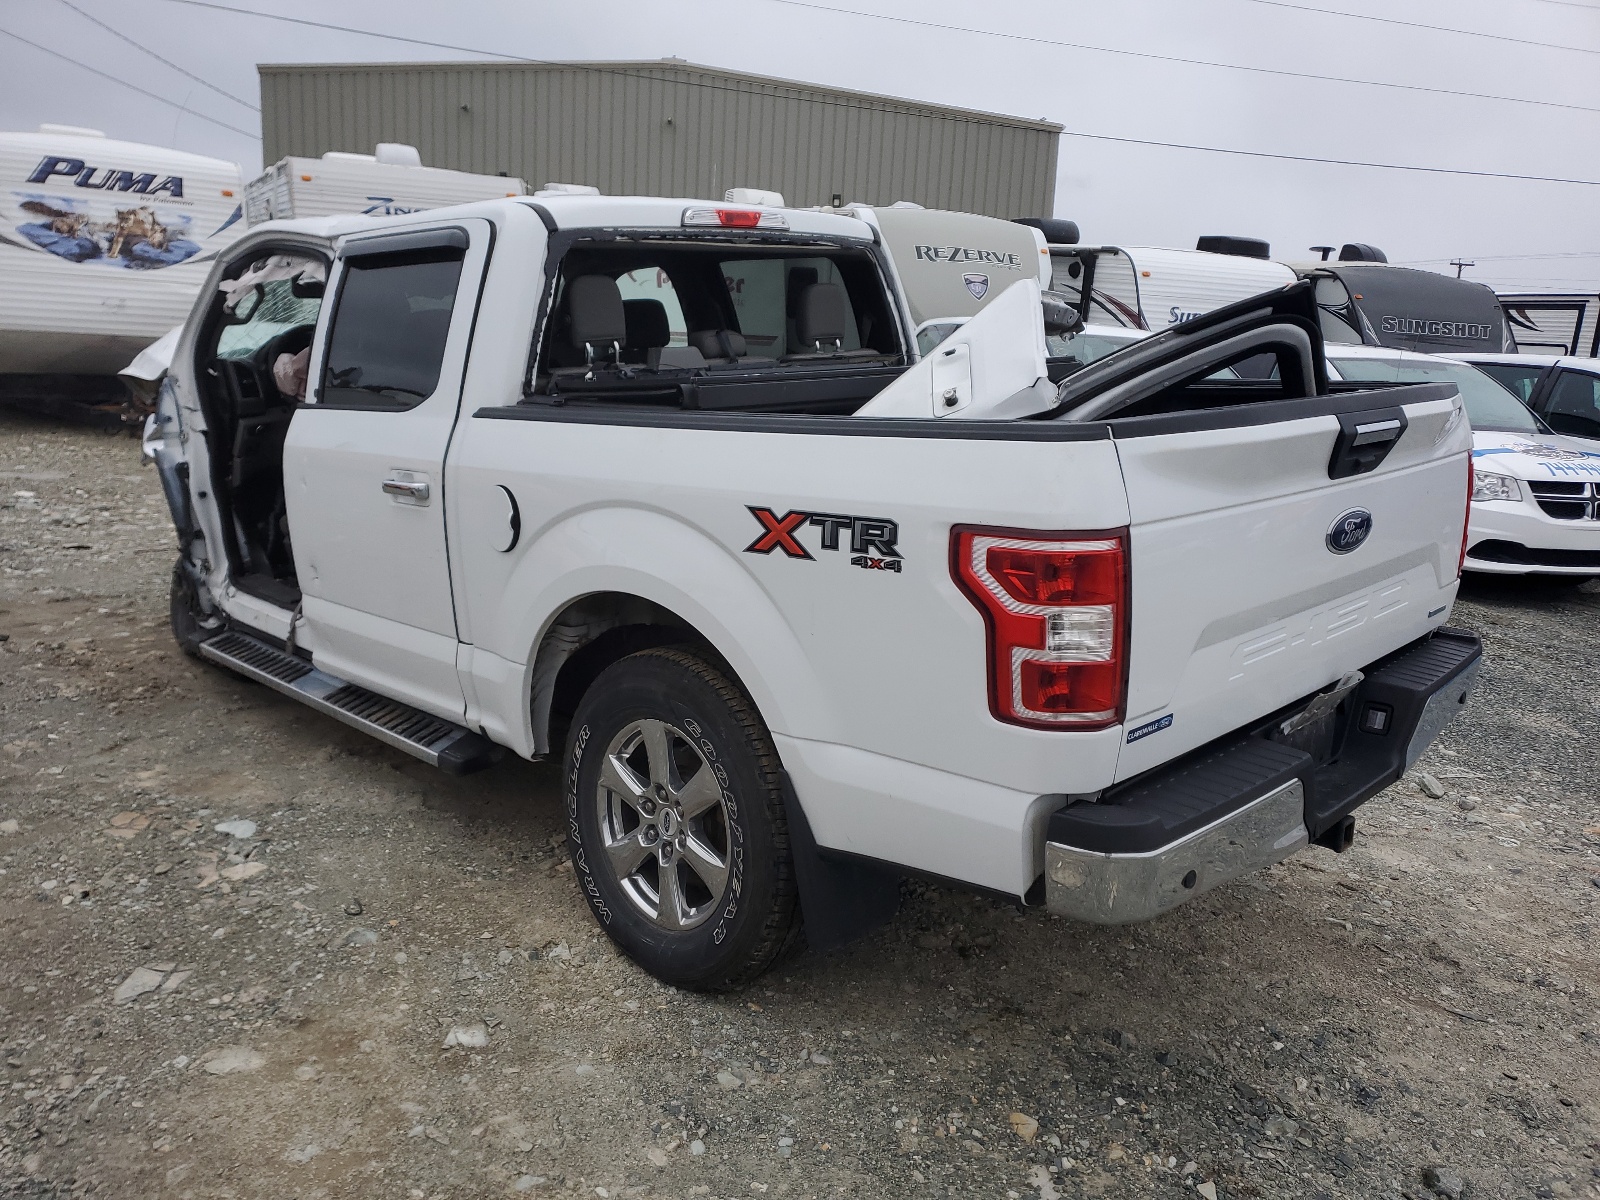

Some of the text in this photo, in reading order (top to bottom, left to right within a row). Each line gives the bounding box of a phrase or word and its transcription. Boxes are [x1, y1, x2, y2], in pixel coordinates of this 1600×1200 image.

[26, 155, 184, 198] PUMA
[1382, 315, 1491, 339] SLINGSHOT
[742, 504, 905, 562] XTR
[567, 724, 612, 925] WRANGLER
[684, 718, 743, 944] GOODYEAR
